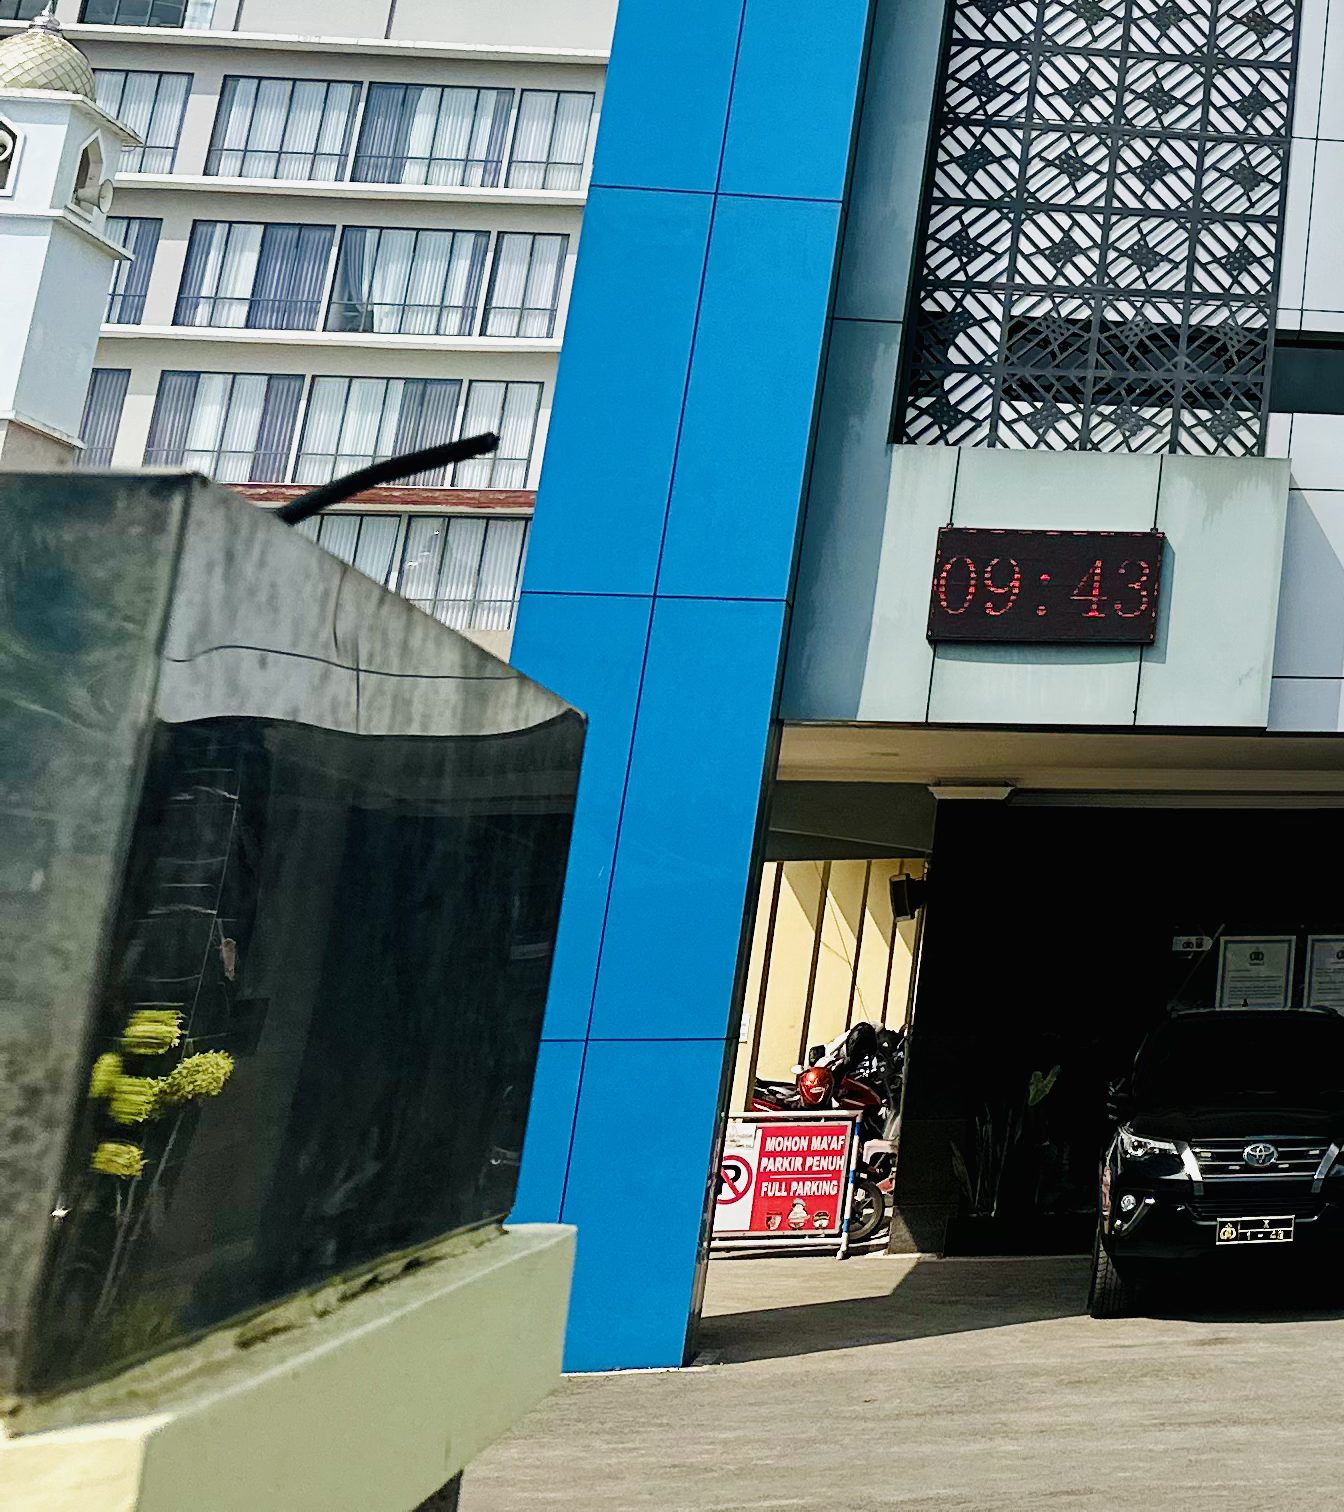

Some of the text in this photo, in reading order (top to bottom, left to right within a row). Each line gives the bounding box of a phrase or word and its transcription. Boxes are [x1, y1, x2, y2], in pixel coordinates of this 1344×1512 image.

[764, 1136, 809, 1152] MOHON
[810, 1135, 846, 1151] MA'AF
[759, 1155, 845, 1172] PARKIR PENUH
[760, 1180, 839, 1197] FULL PARKING
